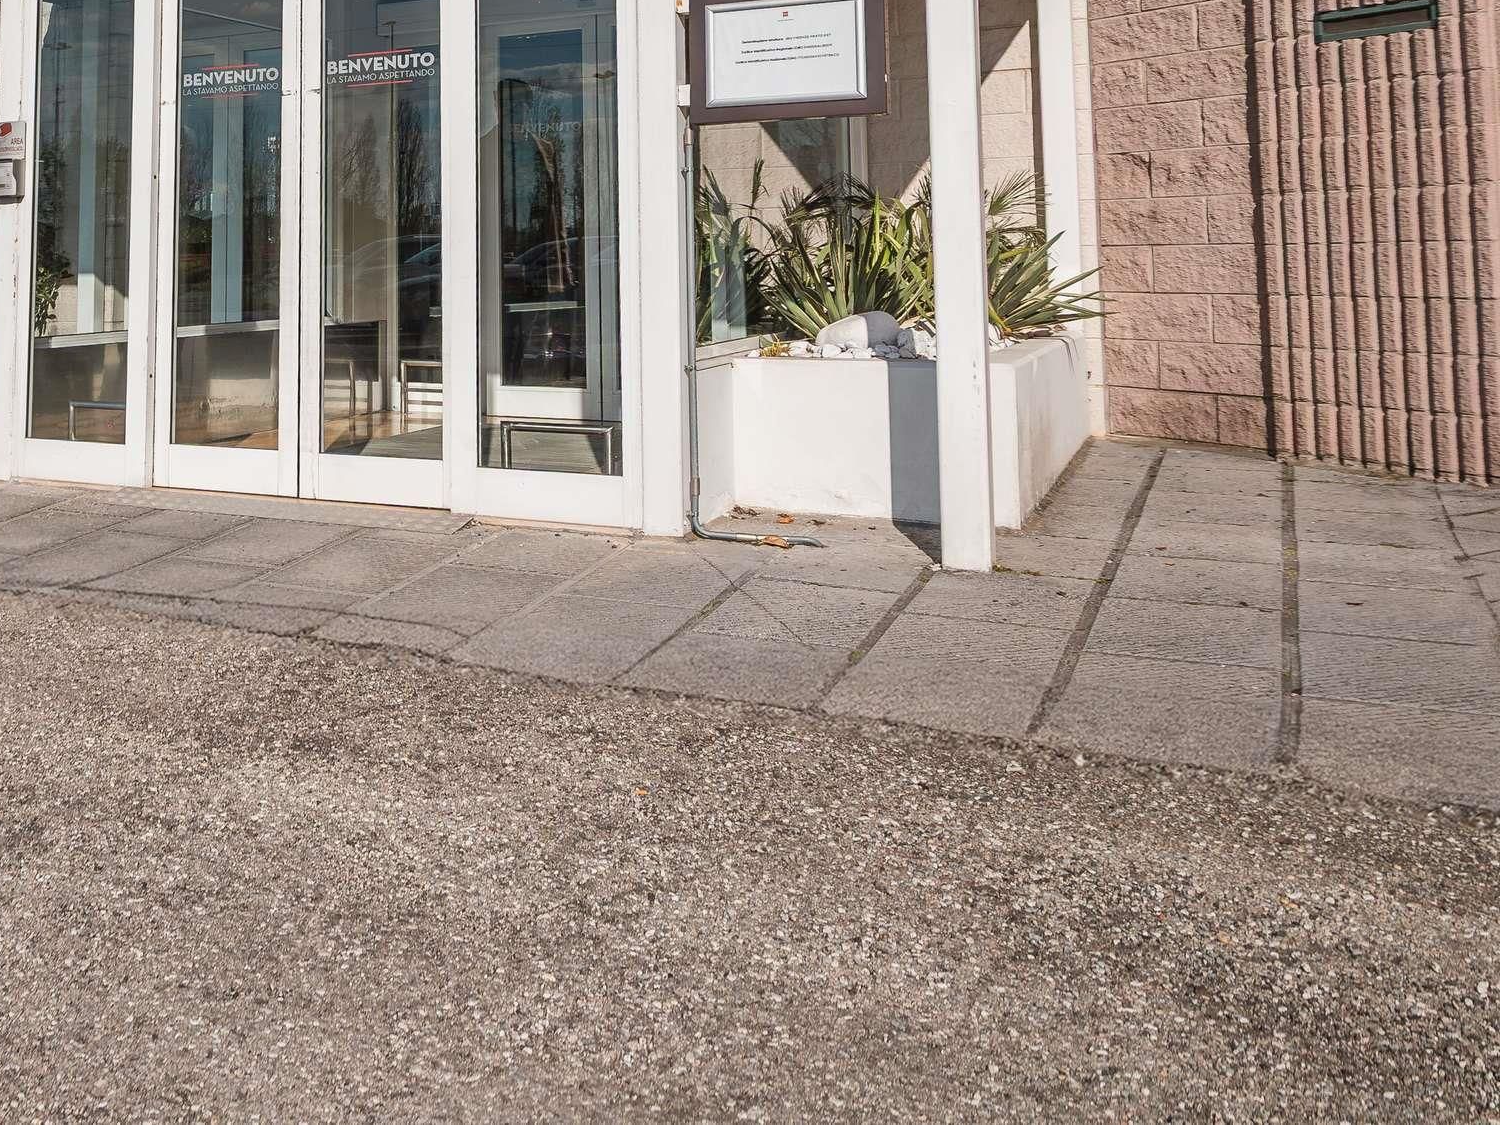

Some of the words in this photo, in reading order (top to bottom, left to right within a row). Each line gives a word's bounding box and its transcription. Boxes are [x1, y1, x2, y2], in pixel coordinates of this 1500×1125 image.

[327, 52, 435, 75] BENVENUTO
[183, 67, 279, 87] BENVENUTO
[327, 76, 337, 85] LA
[338, 73, 377, 84] STAVAMO
[378, 68, 435, 80] ASPETTANDO
[182, 88, 192, 96] LA
[193, 86, 228, 95] STAVAMO
[229, 82, 279, 92] ASPETTANDO
